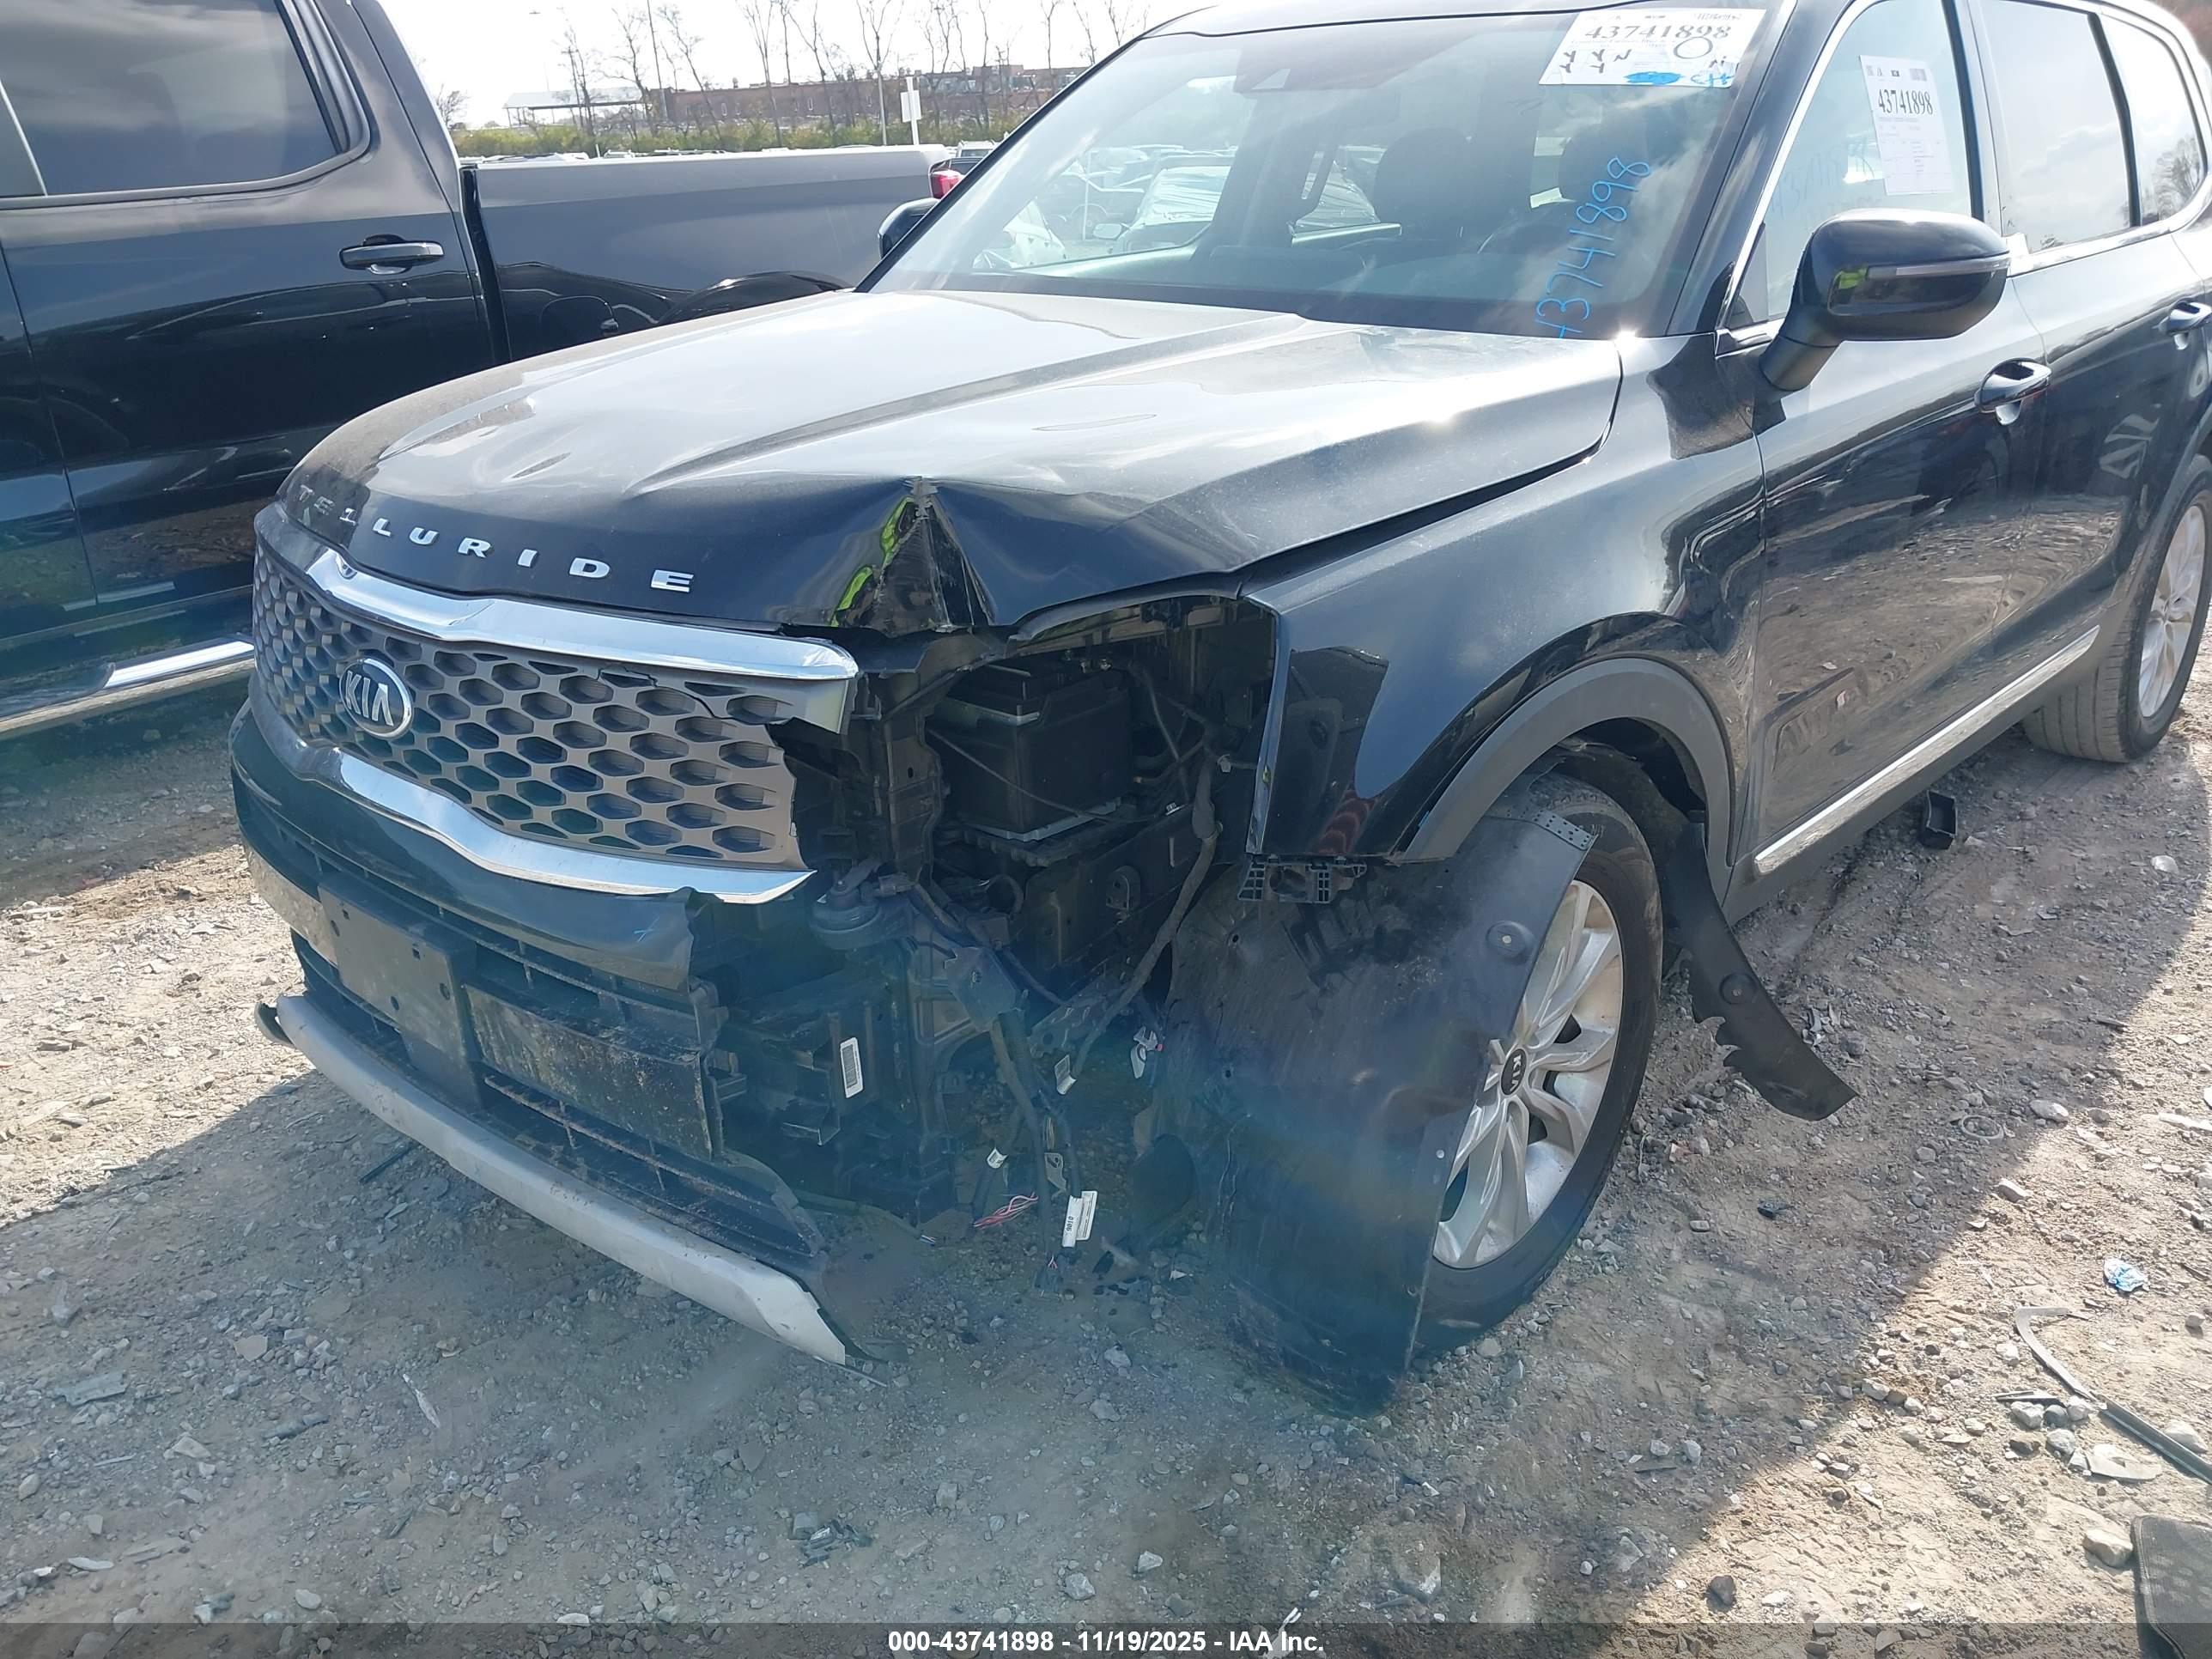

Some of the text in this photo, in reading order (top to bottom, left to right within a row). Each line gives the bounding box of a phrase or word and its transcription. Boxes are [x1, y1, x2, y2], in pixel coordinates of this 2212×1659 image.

[1585, 24, 1732, 40] 43741898
[1878, 88, 1934, 116] 43741898
[345, 670, 394, 726] KIA
[1510, 1054, 1522, 1091] KIA
